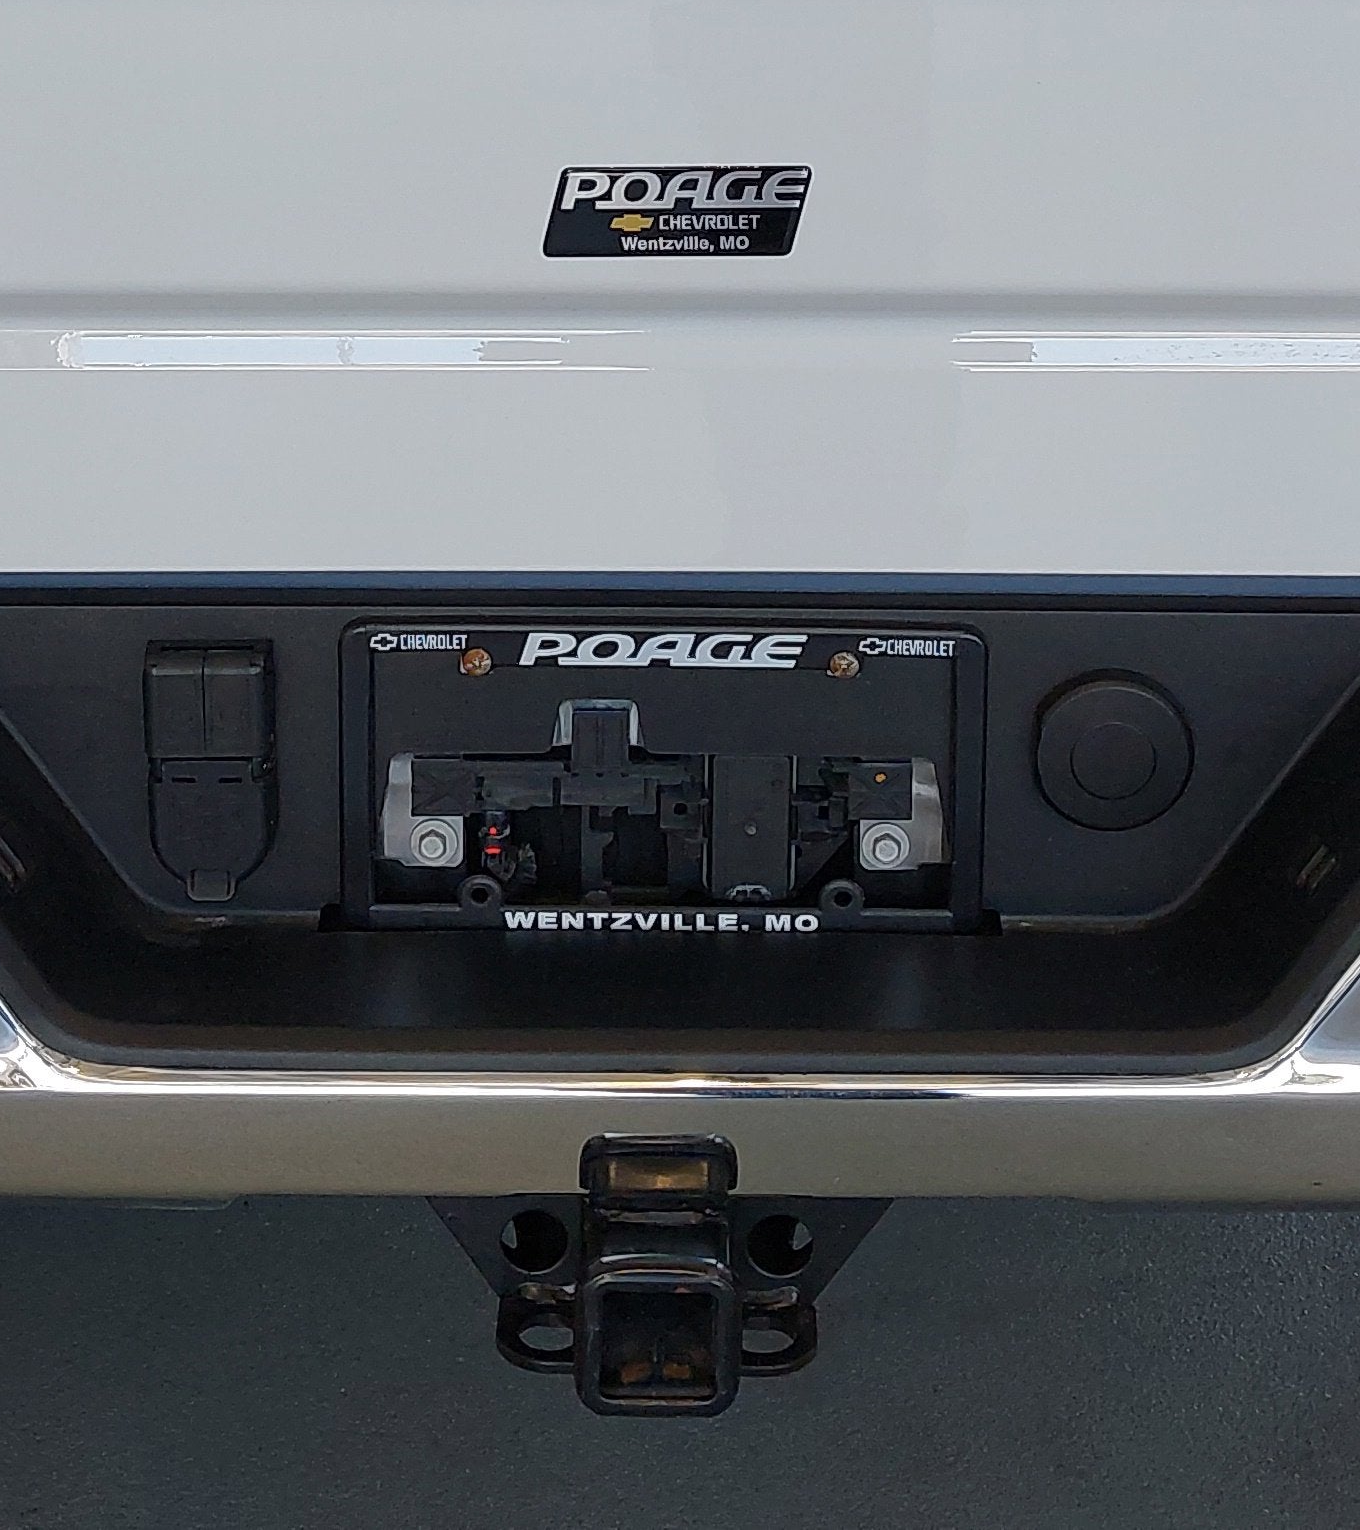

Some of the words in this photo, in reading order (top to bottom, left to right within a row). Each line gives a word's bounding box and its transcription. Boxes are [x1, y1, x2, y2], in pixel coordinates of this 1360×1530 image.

[560, 170, 808, 210] POAGE
[658, 214, 761, 230] CHEVROLET
[621, 235, 715, 252] Wentzville,
[719, 236, 750, 250] MO
[400, 634, 468, 650] CHEVROLET
[519, 632, 809, 668] POAGE
[886, 639, 956, 657] CHEVROLET
[764, 914, 820, 932] MO
